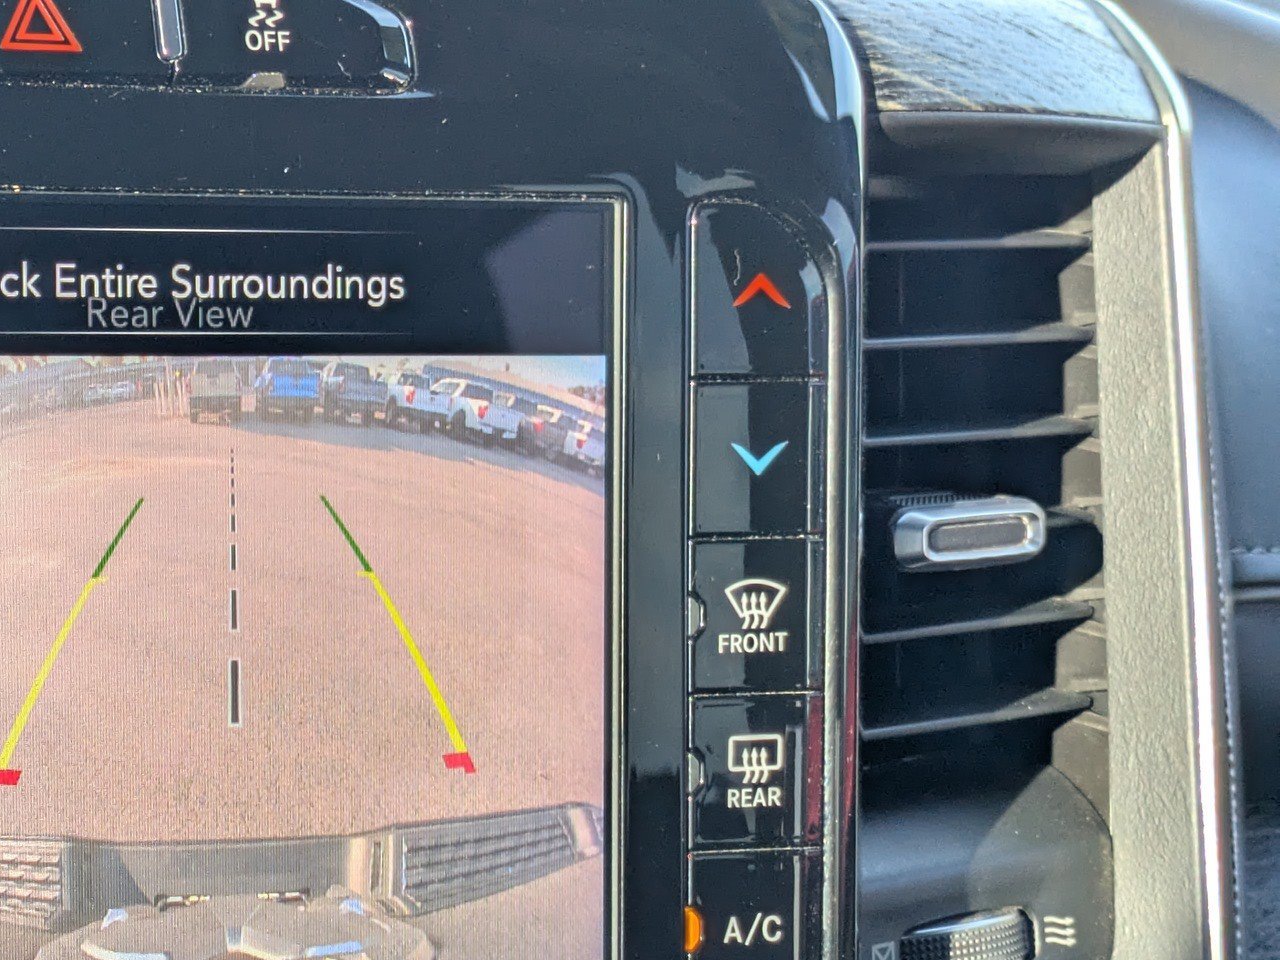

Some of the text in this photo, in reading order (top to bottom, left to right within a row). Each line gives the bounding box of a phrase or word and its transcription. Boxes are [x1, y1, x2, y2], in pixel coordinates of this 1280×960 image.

[245, 29, 290, 53] OFF
[54, 264, 158, 299] Entire
[171, 264, 406, 304] Surroundings
[87, 298, 254, 330] Rear View
[718, 632, 788, 654] FRONT
[727, 787, 782, 808] REAR
[724, 914, 783, 944] A/C
